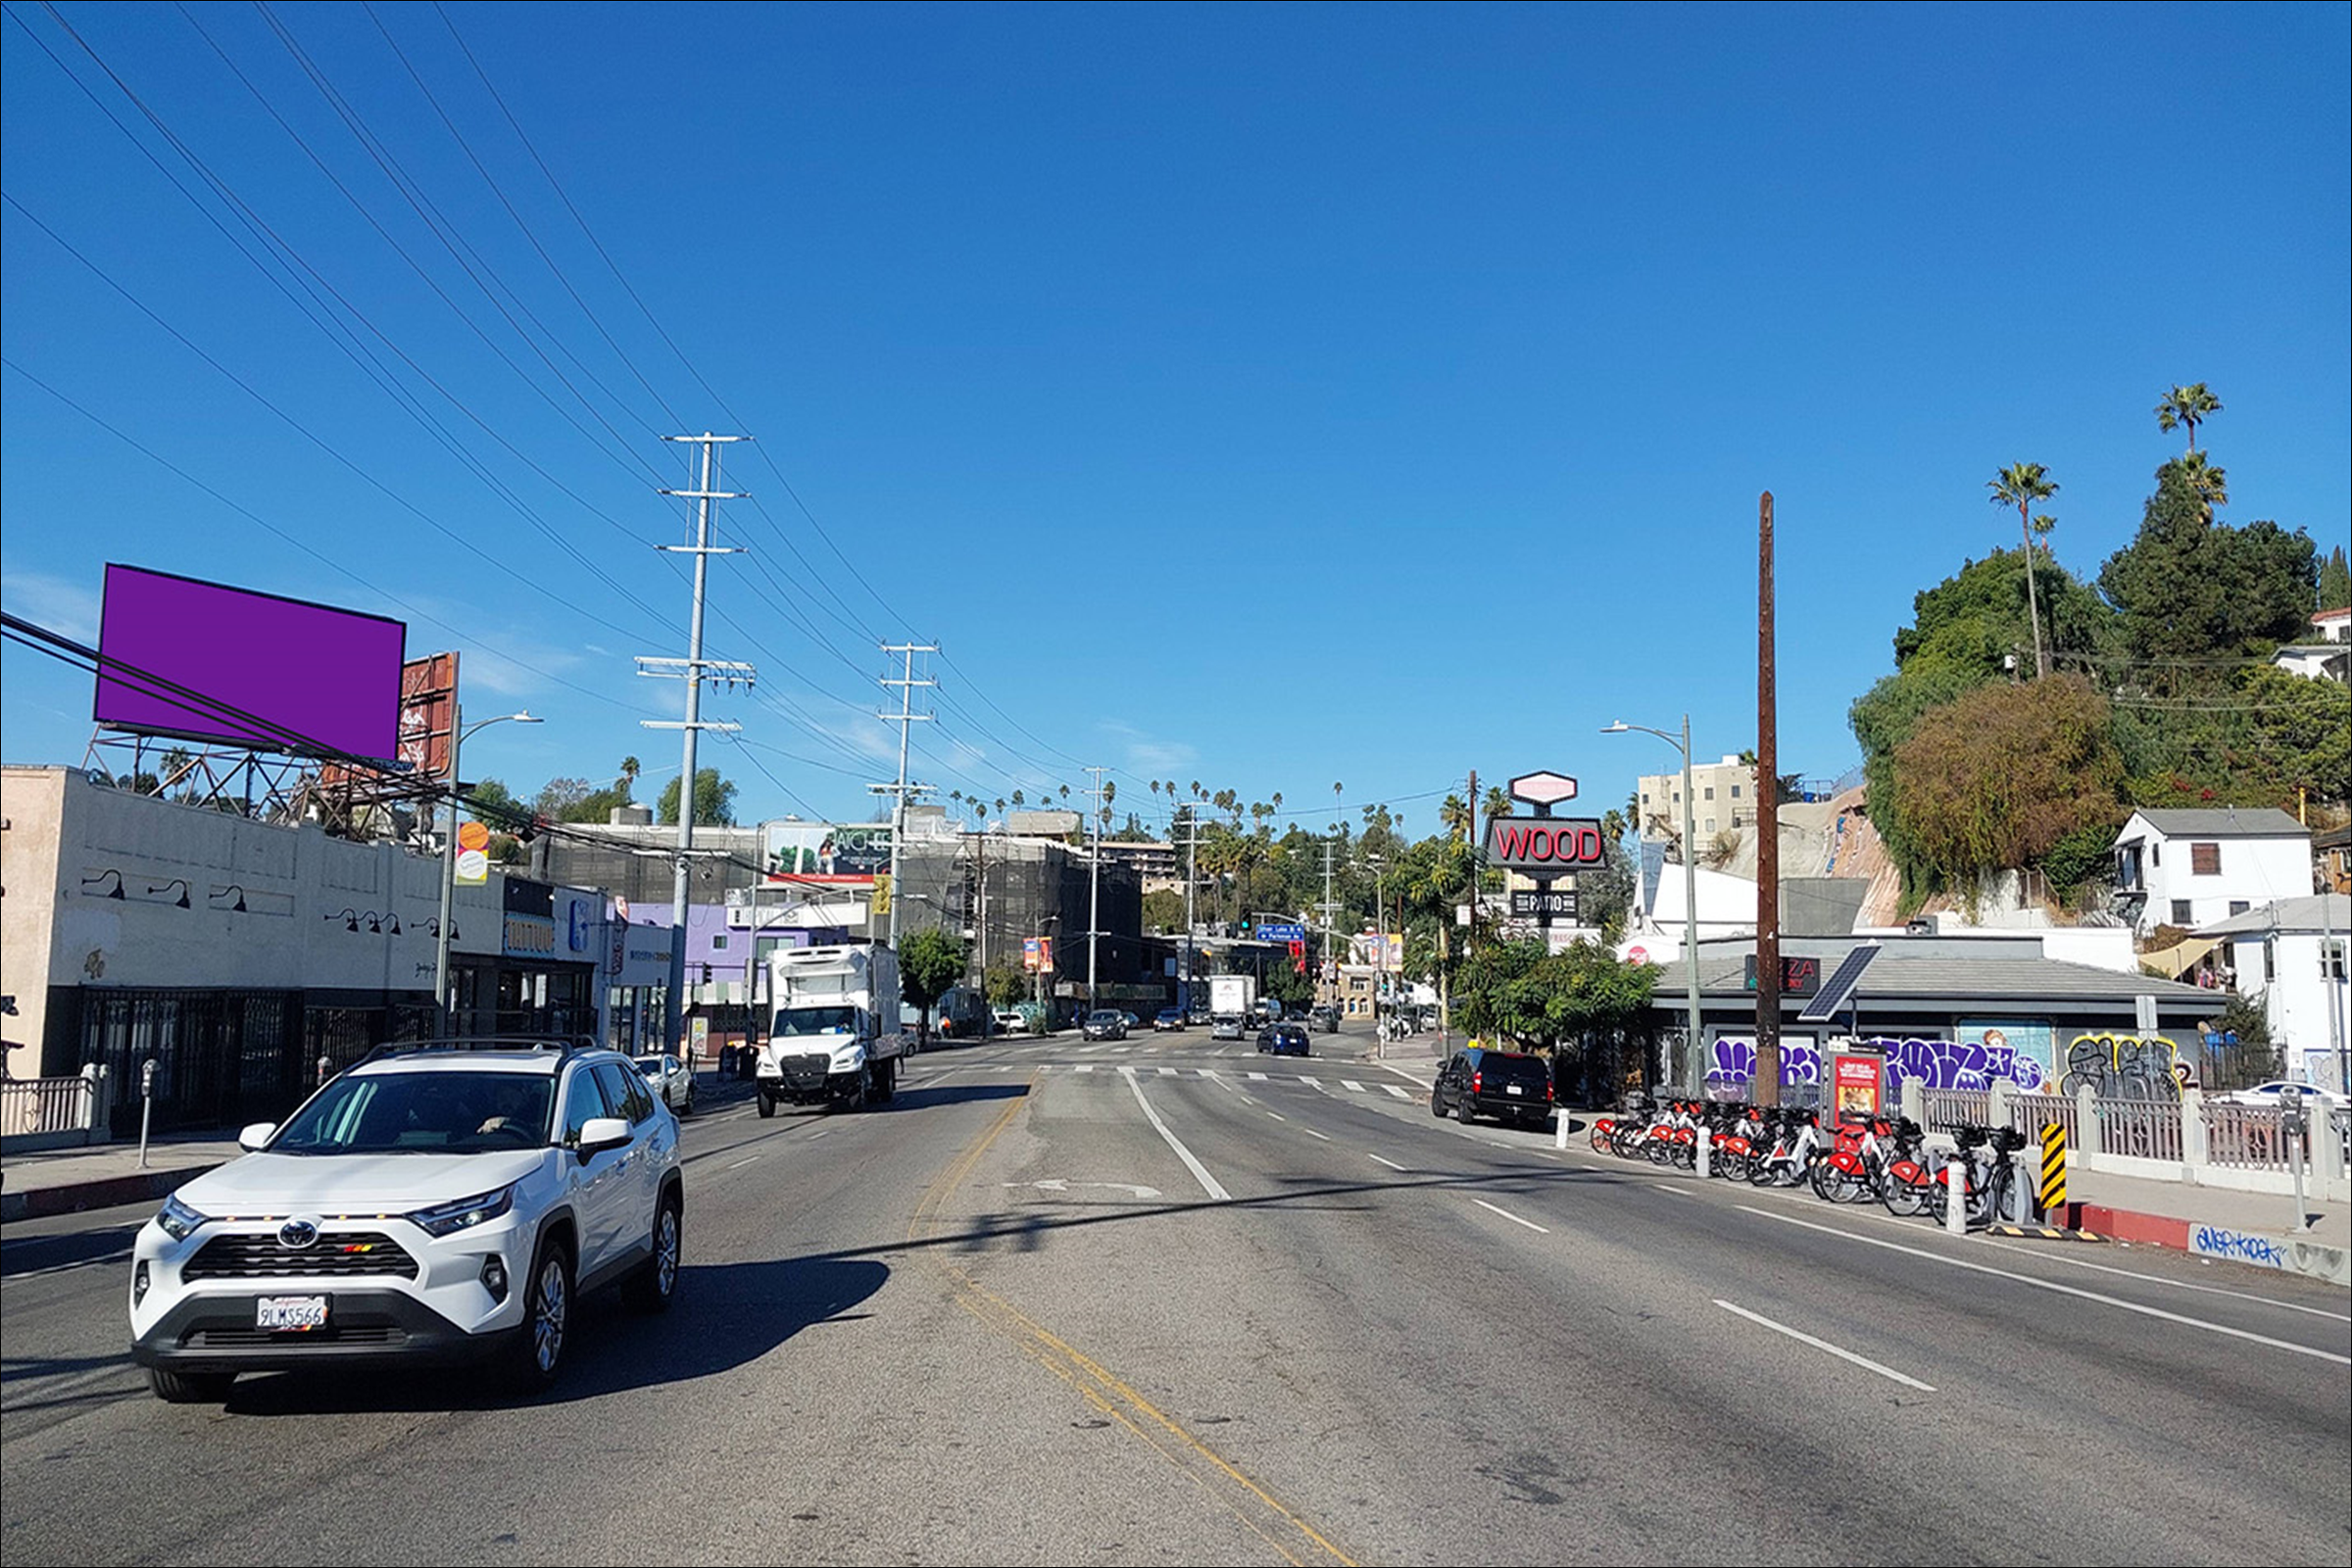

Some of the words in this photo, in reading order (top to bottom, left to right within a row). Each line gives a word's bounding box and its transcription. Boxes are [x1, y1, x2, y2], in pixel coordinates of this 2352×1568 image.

[1495, 825, 1601, 860] WOOD
[1530, 895, 1562, 911] PATIO
[261, 1307, 321, 1325] 9LMS566
